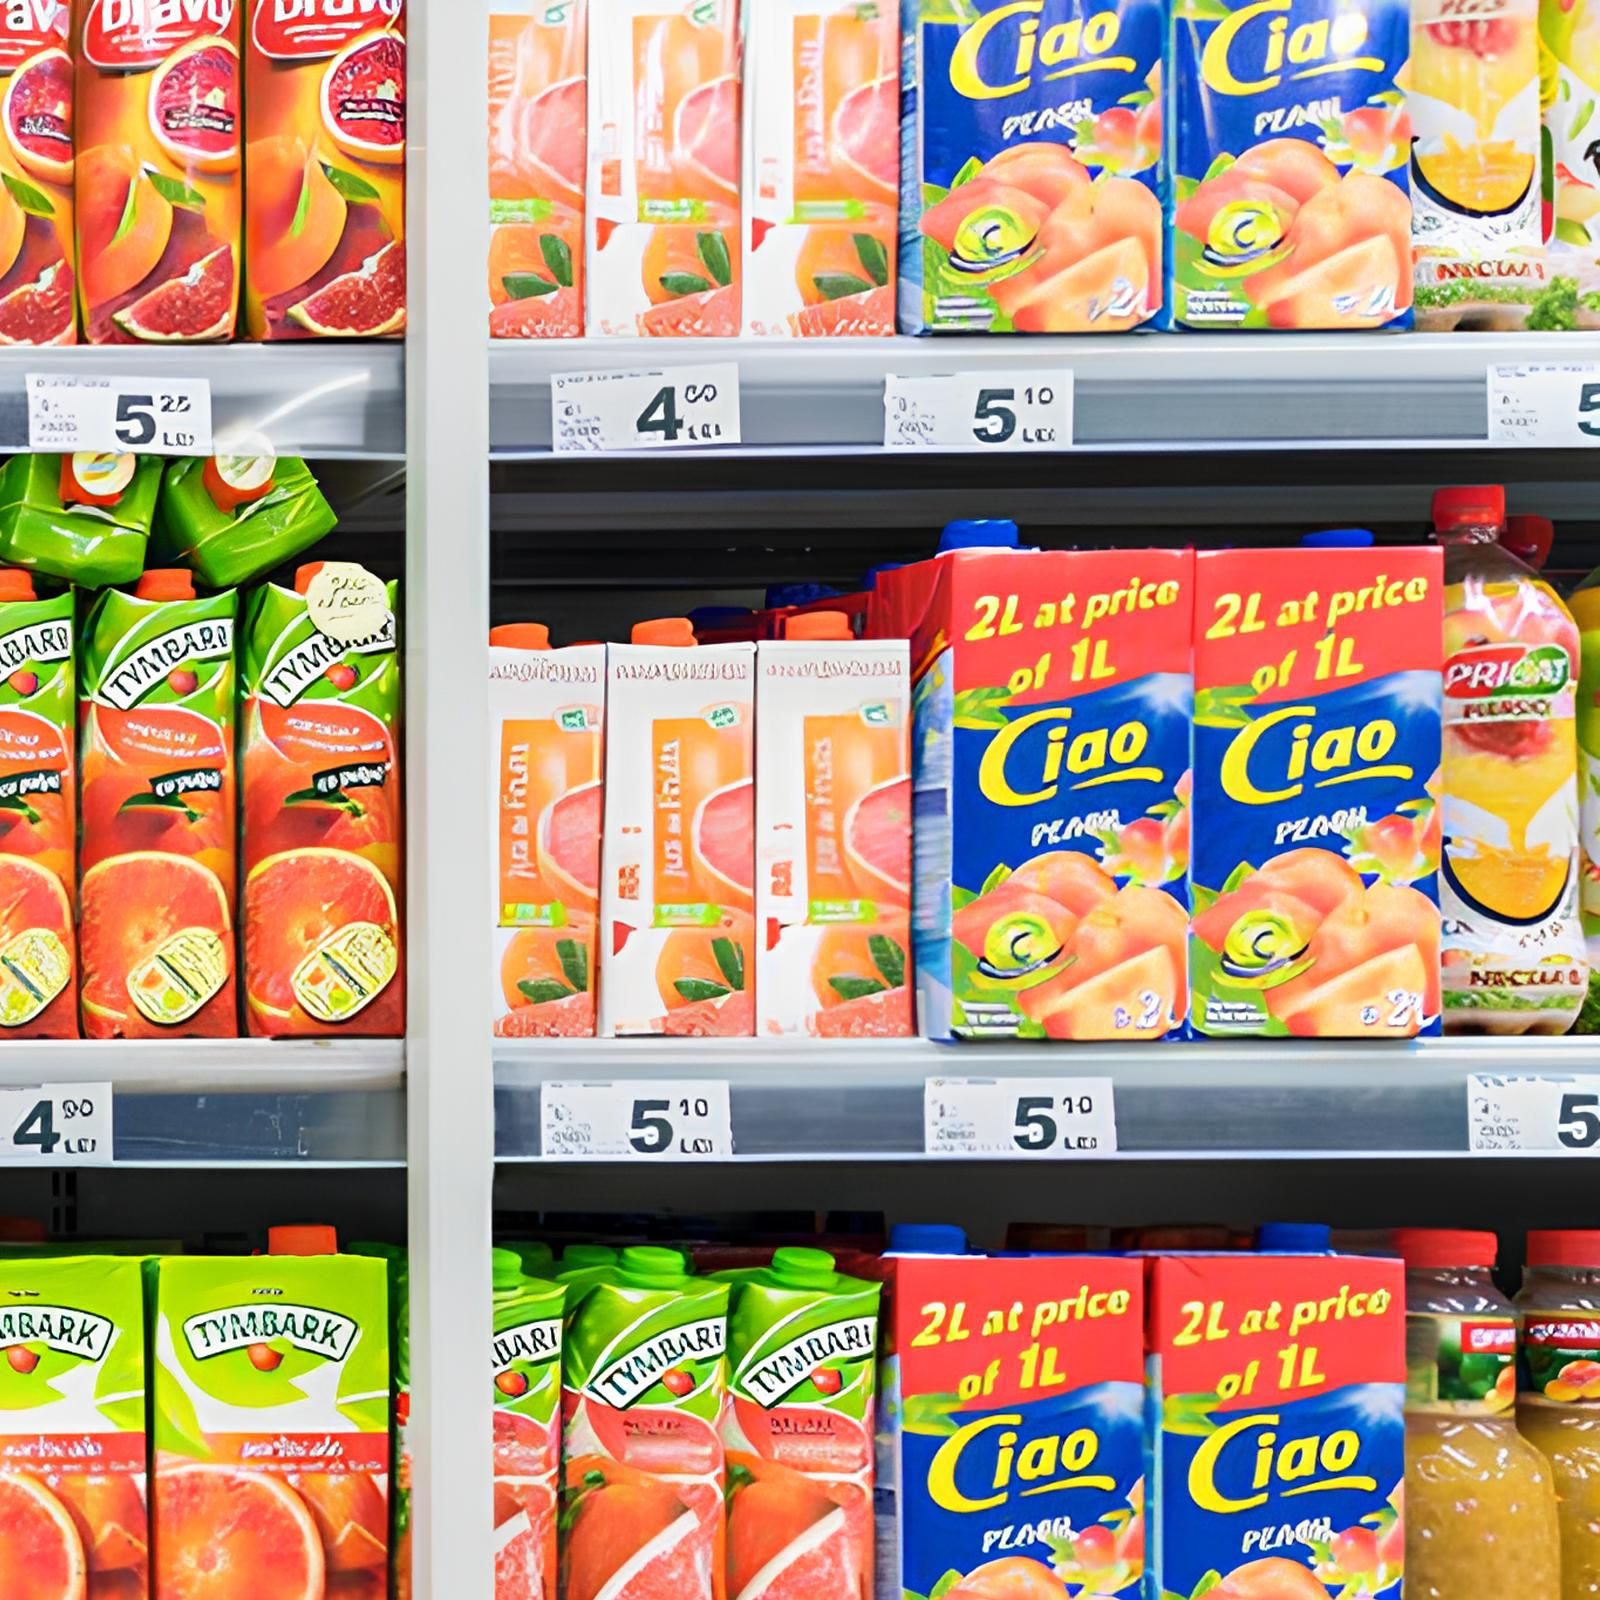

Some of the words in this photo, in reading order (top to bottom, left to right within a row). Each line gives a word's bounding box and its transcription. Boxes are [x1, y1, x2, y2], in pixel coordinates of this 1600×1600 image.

[115, 396, 156, 444] 5
[637, 387, 683, 440] 4
[974, 389, 1016, 442] 5
[966, 596, 1021, 643] 2L
[1033, 595, 1074, 629] at
[1081, 577, 1180, 631] price
[1206, 593, 1265, 639] 2L
[1277, 590, 1318, 627] at
[1328, 575, 1428, 626] price
[978, 707, 1148, 806] Ciao
[1220, 706, 1397, 805] Ciao
[12, 1101, 60, 1153] 4
[629, 1100, 674, 1153] 5
[680, 1099, 708, 1118] 10
[1013, 1096, 1057, 1150] 5
[1064, 1096, 1092, 1114] 10
[911, 1303, 970, 1347] 2L
[982, 1300, 1022, 1337] at
[1032, 1285, 1130, 1337] price
[1173, 1300, 1228, 1346] 2L
[1240, 1300, 1278, 1336] at
[1292, 1285, 1391, 1331] price
[928, 1414, 1099, 1512] Ciao
[1189, 1415, 1361, 1512] Ciao
